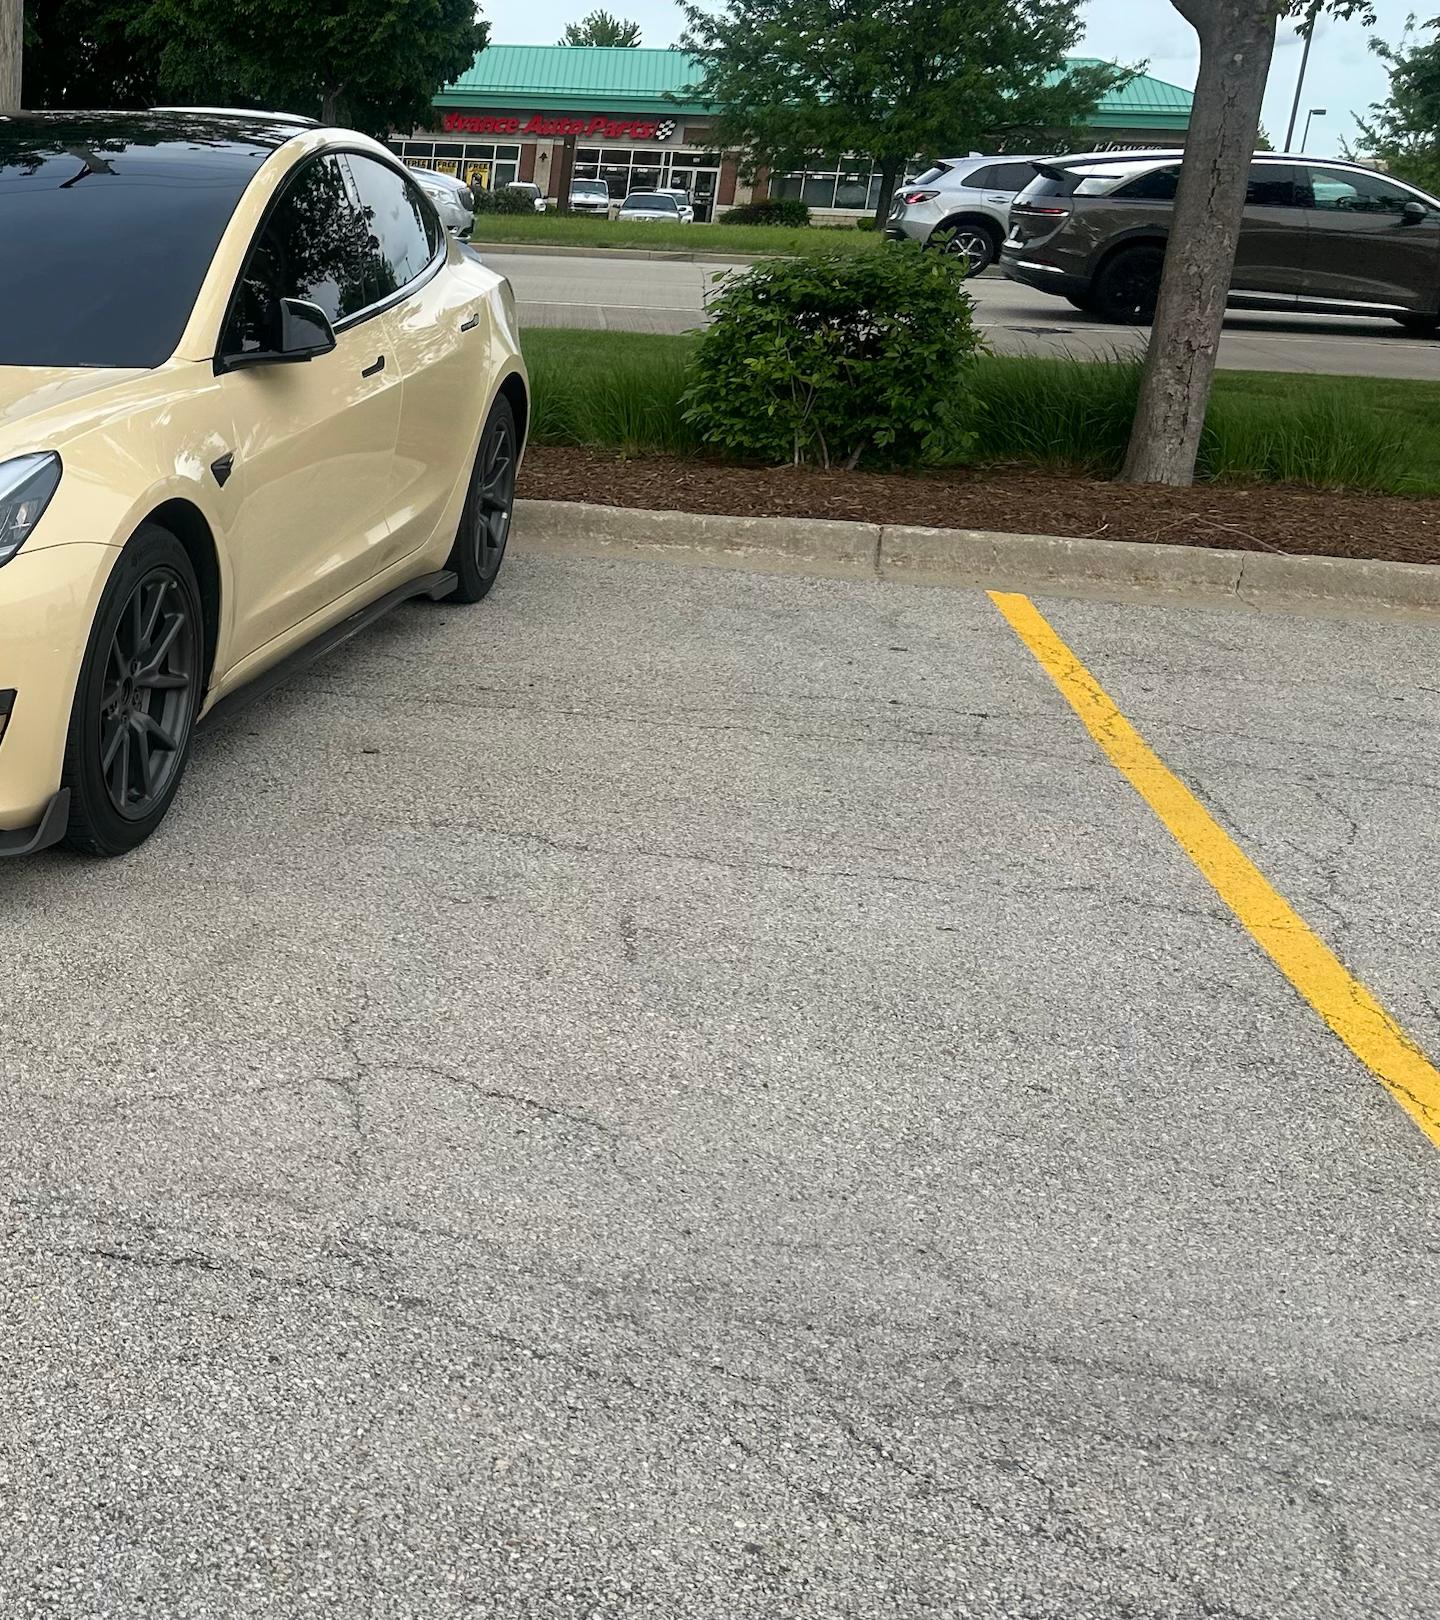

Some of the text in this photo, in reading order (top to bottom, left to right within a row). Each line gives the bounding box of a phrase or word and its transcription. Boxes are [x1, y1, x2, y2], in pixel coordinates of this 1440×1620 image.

[444, 112, 654, 140] dvance Auto Parts
[437, 160, 457, 168] FREE
[469, 162, 488, 170] FREE
